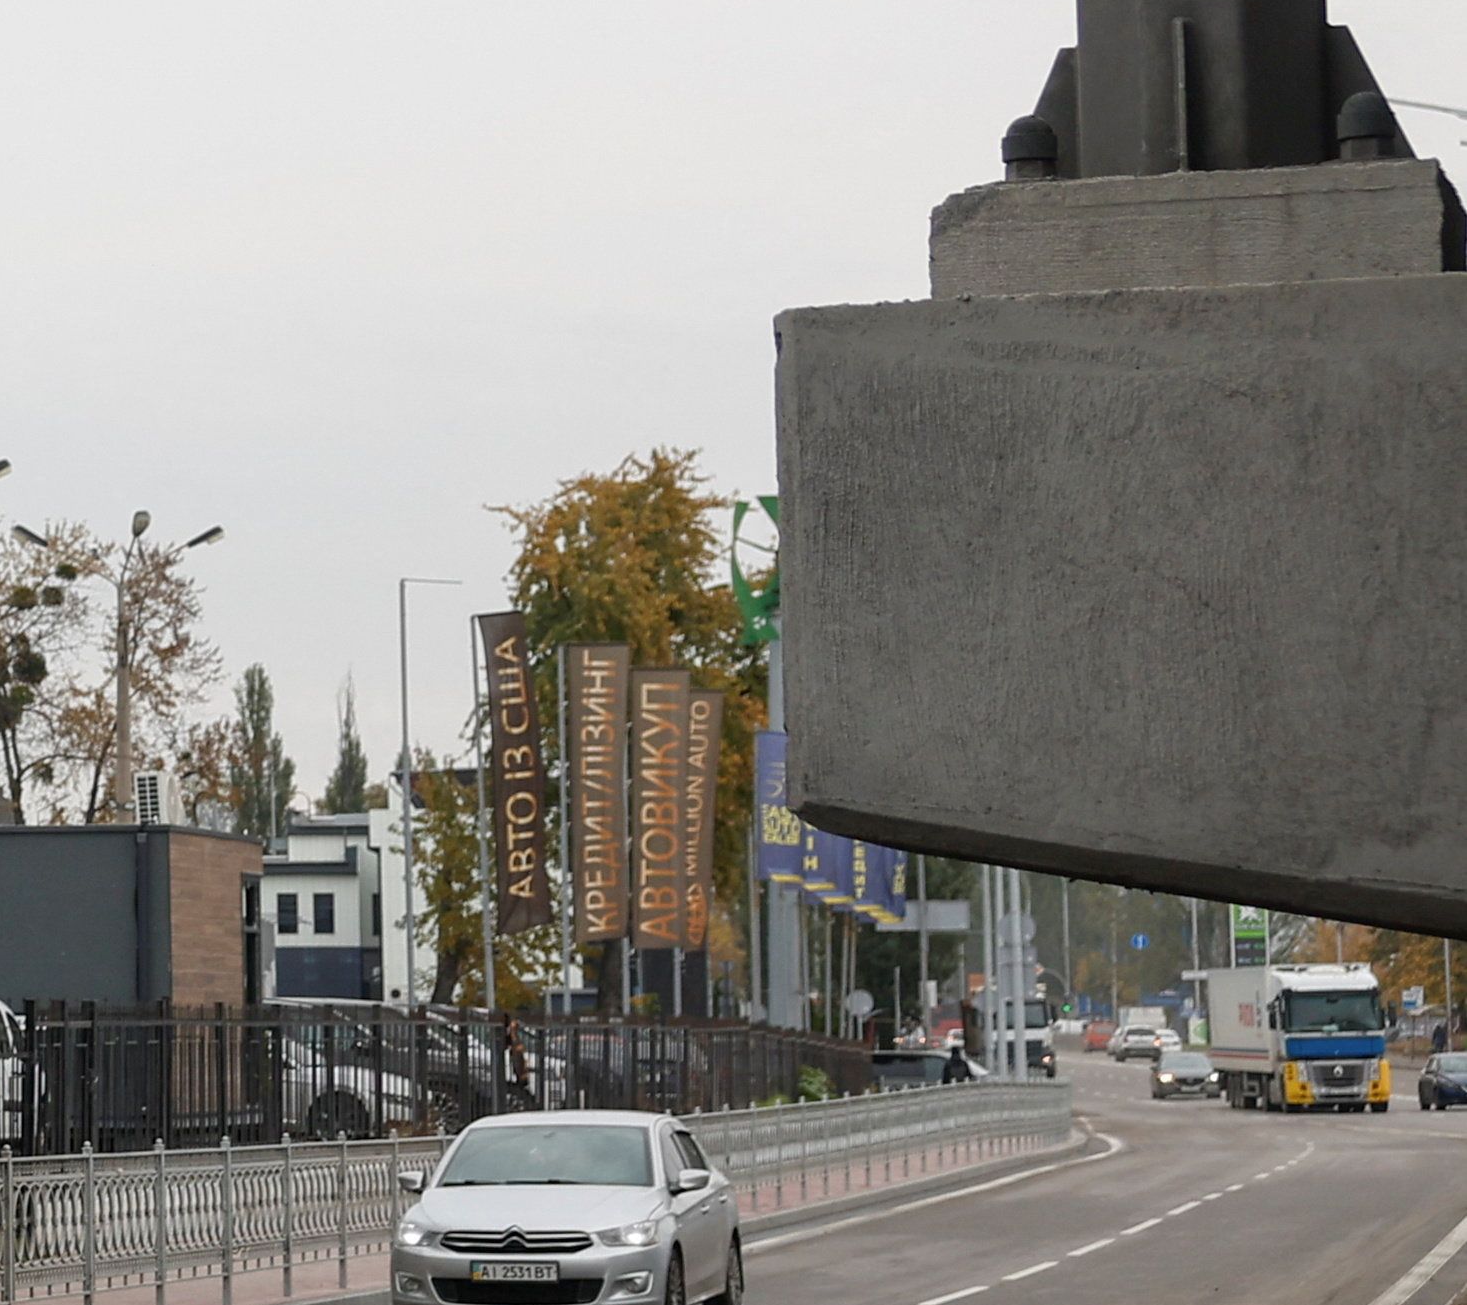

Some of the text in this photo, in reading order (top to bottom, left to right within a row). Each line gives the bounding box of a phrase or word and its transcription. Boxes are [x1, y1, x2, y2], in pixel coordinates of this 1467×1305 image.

[495, 636, 539, 899] АВТО ІЗ США
[581, 649, 620, 934] КРЕДИТ/ЛІЗИНГ
[639, 682, 683, 941] АВТОВИКУП
[688, 699, 711, 769] AUTO
